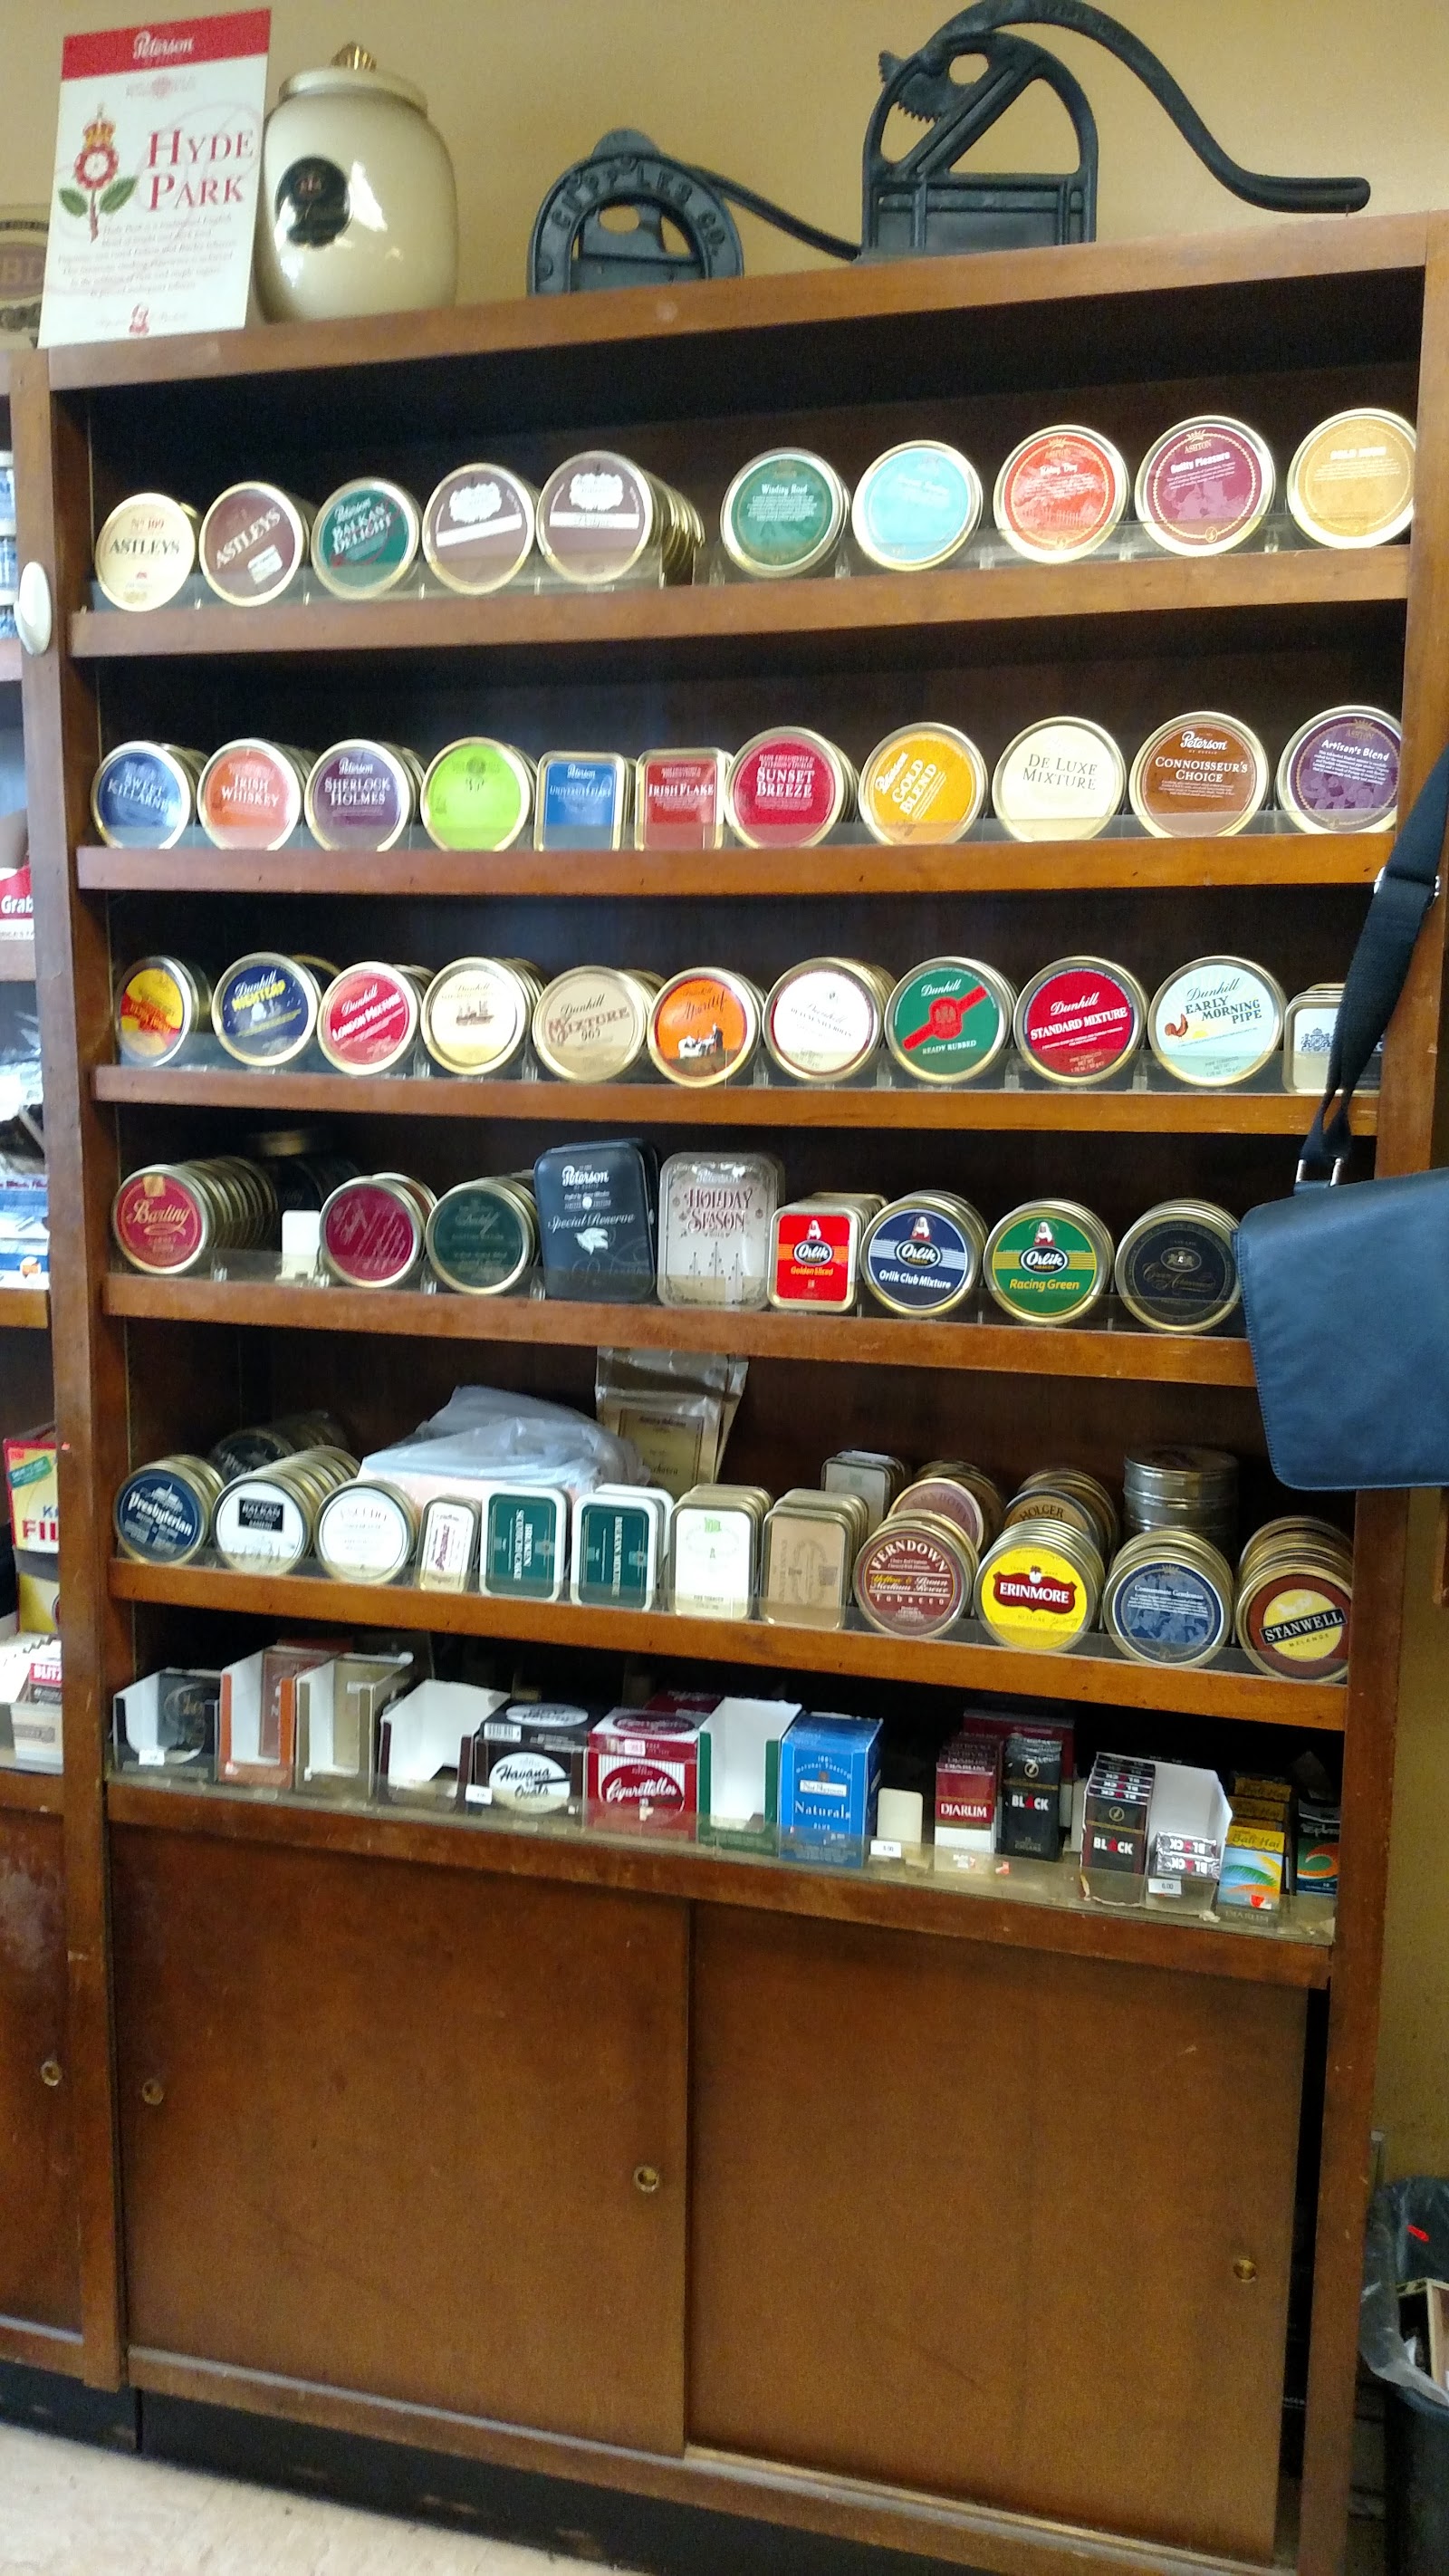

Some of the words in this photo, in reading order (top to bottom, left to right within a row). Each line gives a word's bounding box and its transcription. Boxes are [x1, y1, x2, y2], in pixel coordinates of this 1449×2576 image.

[148, 129, 254, 168] HYDE
[149, 174, 244, 212] PARK
[1185, 439, 1212, 454] ASHTON
[1195, 451, 1230, 467] Pleasure
[761, 484, 790, 496] Winding
[791, 484, 808, 494] Road
[110, 537, 179, 555] ASTLEYS
[216, 508, 282, 569] ASTLEYS
[1180, 731, 1227, 750] Peterson
[1321, 739, 1361, 755] Artisan's
[1362, 747, 1390, 761] Blend
[339, 757, 373, 775] Peterson
[1029, 754, 1051, 768] DE
[1056, 757, 1099, 776] LUXE
[1155, 756, 1248, 773] CONNOISSEUR'S
[757, 767, 815, 784] SUNSET
[891, 759, 924, 803] GOLD
[1022, 767, 1097, 791] MIXTURE
[1176, 769, 1223, 783] CHOICE
[325, 777, 390, 794] SHERLOCK
[648, 783, 677, 797] IRISH
[679, 783, 715, 797] FLAKE
[757, 782, 812, 798] BREEZE
[899, 764, 936, 814] BLEND
[108, 779, 172, 814] KILLARNE
[221, 785, 279, 807] WHISKEY
[330, 790, 386, 806] HOLMES
[234, 969, 277, 999] Dunhill
[921, 979, 962, 997] Dunhill
[1186, 977, 1241, 1002] Dunhill
[341, 983, 377, 1017] Dunhill
[561, 995, 605, 1014] Dunhill
[1051, 992, 1099, 1016] Dunhill
[1185, 995, 1229, 1015] EARLY
[1201, 999, 1262, 1022] MORNING
[1232, 1009, 1263, 1025] PIPE
[547, 1006, 630, 1047] MIXTURE
[1030, 1019, 1082, 1041] STANDARD
[1083, 1006, 1128, 1027] MIXTURE
[581, 1028, 601, 1042] 965
[922, 1045, 946, 1055] READY
[947, 1040, 976, 1052] RUBBED
[561, 1165, 609, 1187] Peterson
[686, 1187, 753, 1209] HOLIDAY
[547, 1214, 587, 1233] Special
[587, 1212, 636, 1226] Reserve
[688, 1209, 746, 1233] SEASON
[799, 1245, 830, 1260] Orlik
[901, 1245, 936, 1263] Orlik
[1024, 1252, 1064, 1267] Orlik
[790, 1266, 814, 1276] Golden
[878, 1269, 898, 1282] Orlik
[899, 1272, 918, 1284] Club
[918, 1275, 952, 1290] Mixture
[1009, 1278, 1046, 1292] Racing
[1049, 1278, 1080, 1291] Green
[127, 1491, 194, 1537] Presbyterian
[1020, 1504, 1064, 1521] HOLGER
[871, 1540, 948, 1572] FERNDOWN
[999, 1582, 1070, 1604] ERINMORE
[1134, 1584, 1172, 1596] Consummate
[1172, 1590, 1204, 1600] Gentleman
[1264, 1611, 1343, 1642] STANWELL
[1289, 1632, 1329, 1648] MELANGE
[496, 1765, 552, 1783] Havana
[794, 1800, 851, 1820] Naturals
[941, 1802, 987, 1818] DJARUM
[1012, 1794, 1050, 1812] BLACK
[1093, 1837, 1134, 1855] BLACK
[1231, 1833, 1255, 1845] Bali
[1260, 1837, 1281, 1850] Hai
